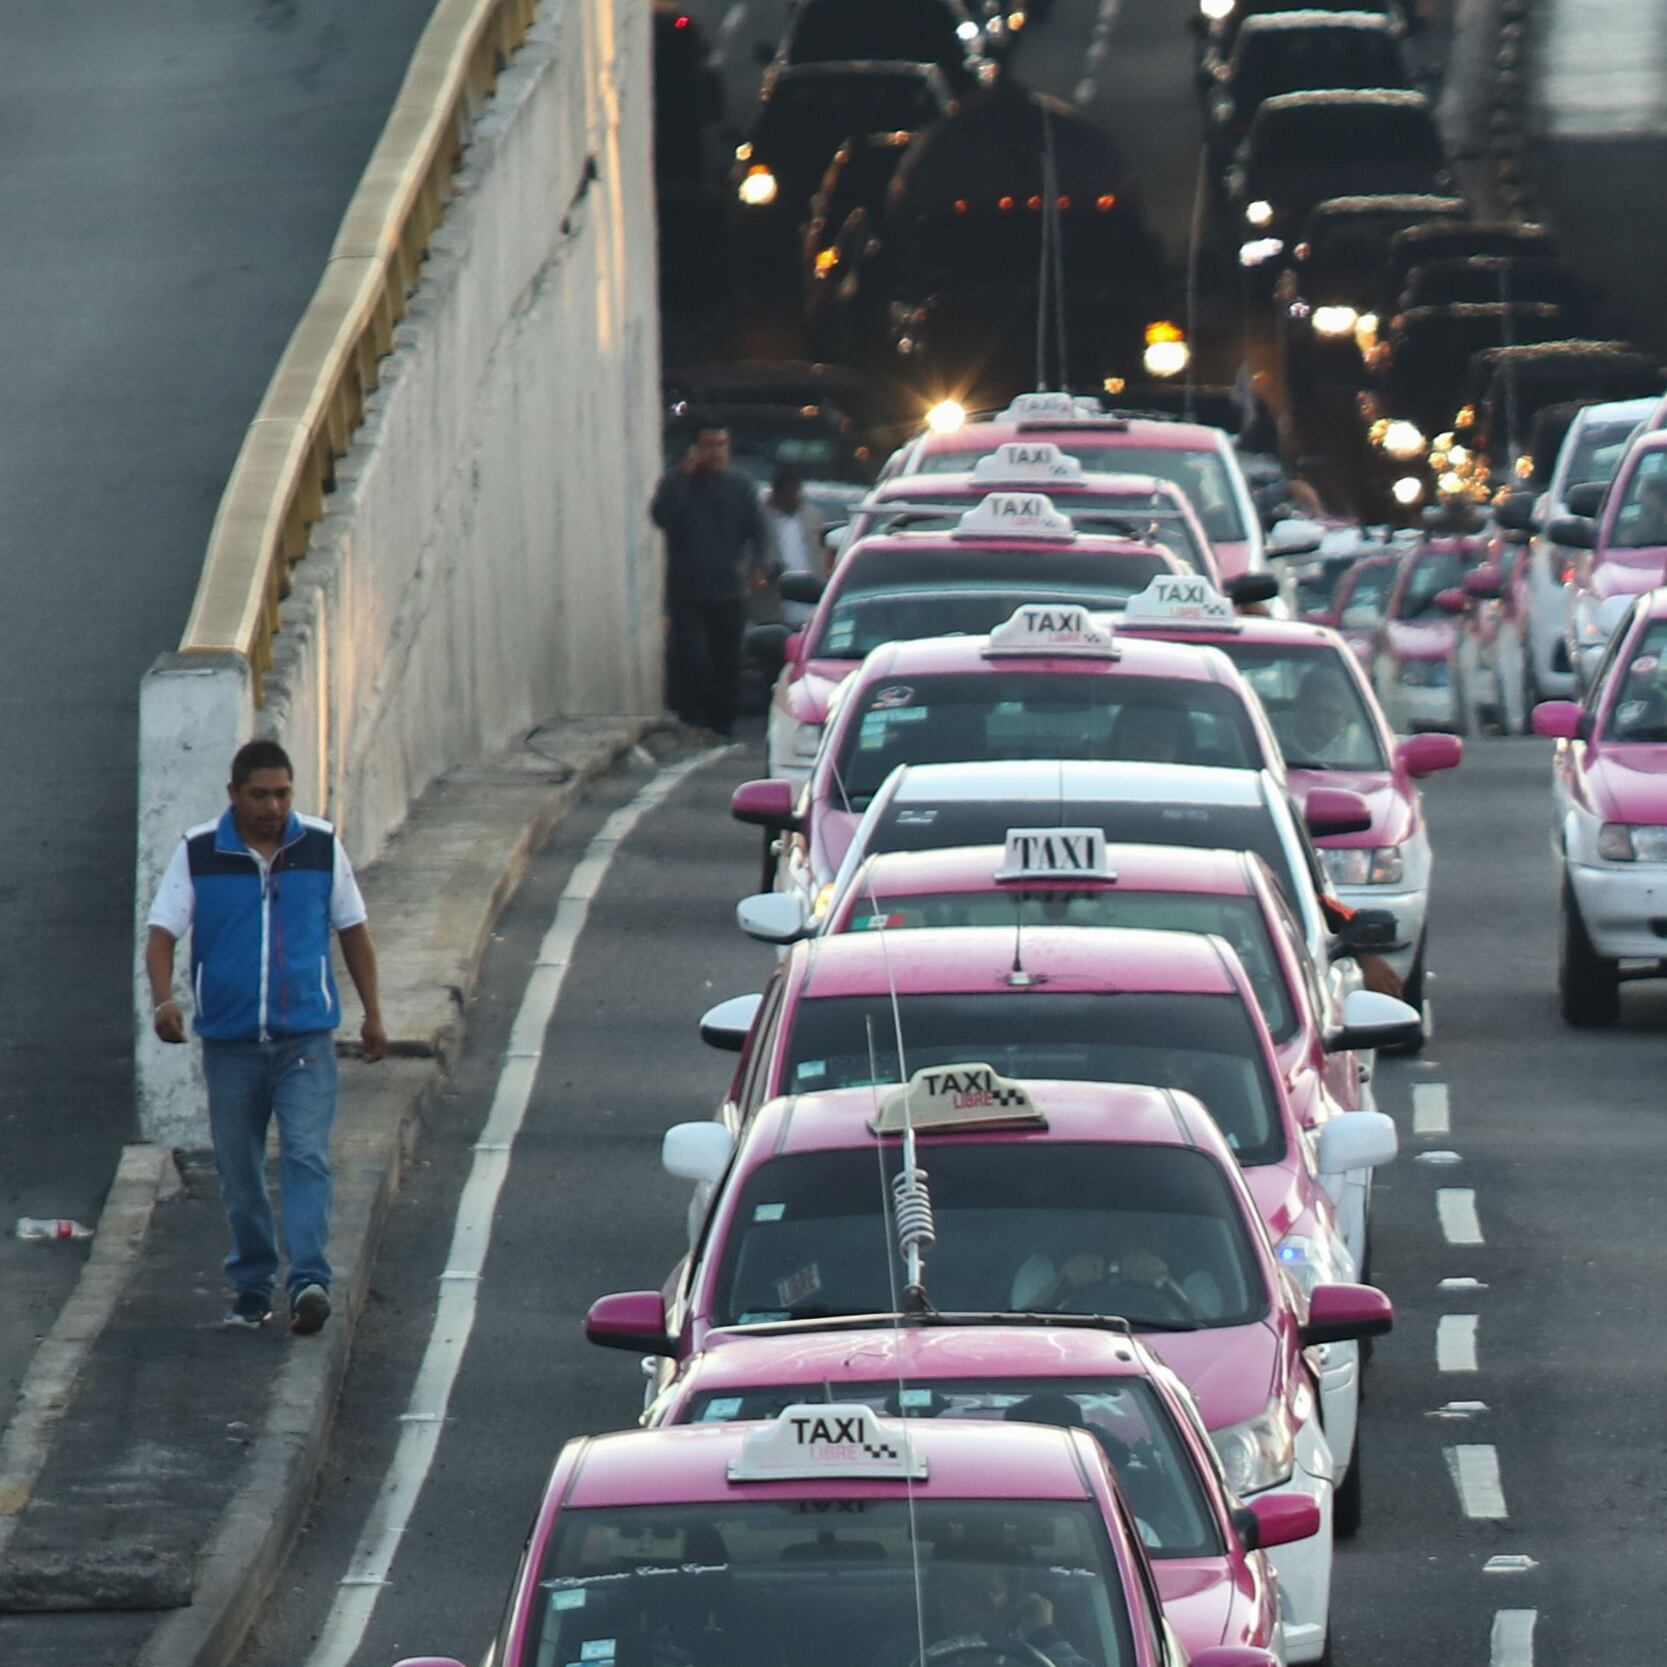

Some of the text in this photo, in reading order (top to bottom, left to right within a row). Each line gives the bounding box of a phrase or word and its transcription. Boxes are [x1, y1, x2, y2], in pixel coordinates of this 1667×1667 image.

[1008, 448, 1051, 464] TAXI
[990, 498, 1039, 516] TAXI
[1156, 585, 1204, 603] TAXI
[1023, 612, 1081, 632] TAXI
[1012, 836, 1095, 870] TAXI
[922, 1070, 993, 1096] TAXI
[953, 1091, 993, 1109] LIBRE
[791, 1417, 864, 1445] TAXI
